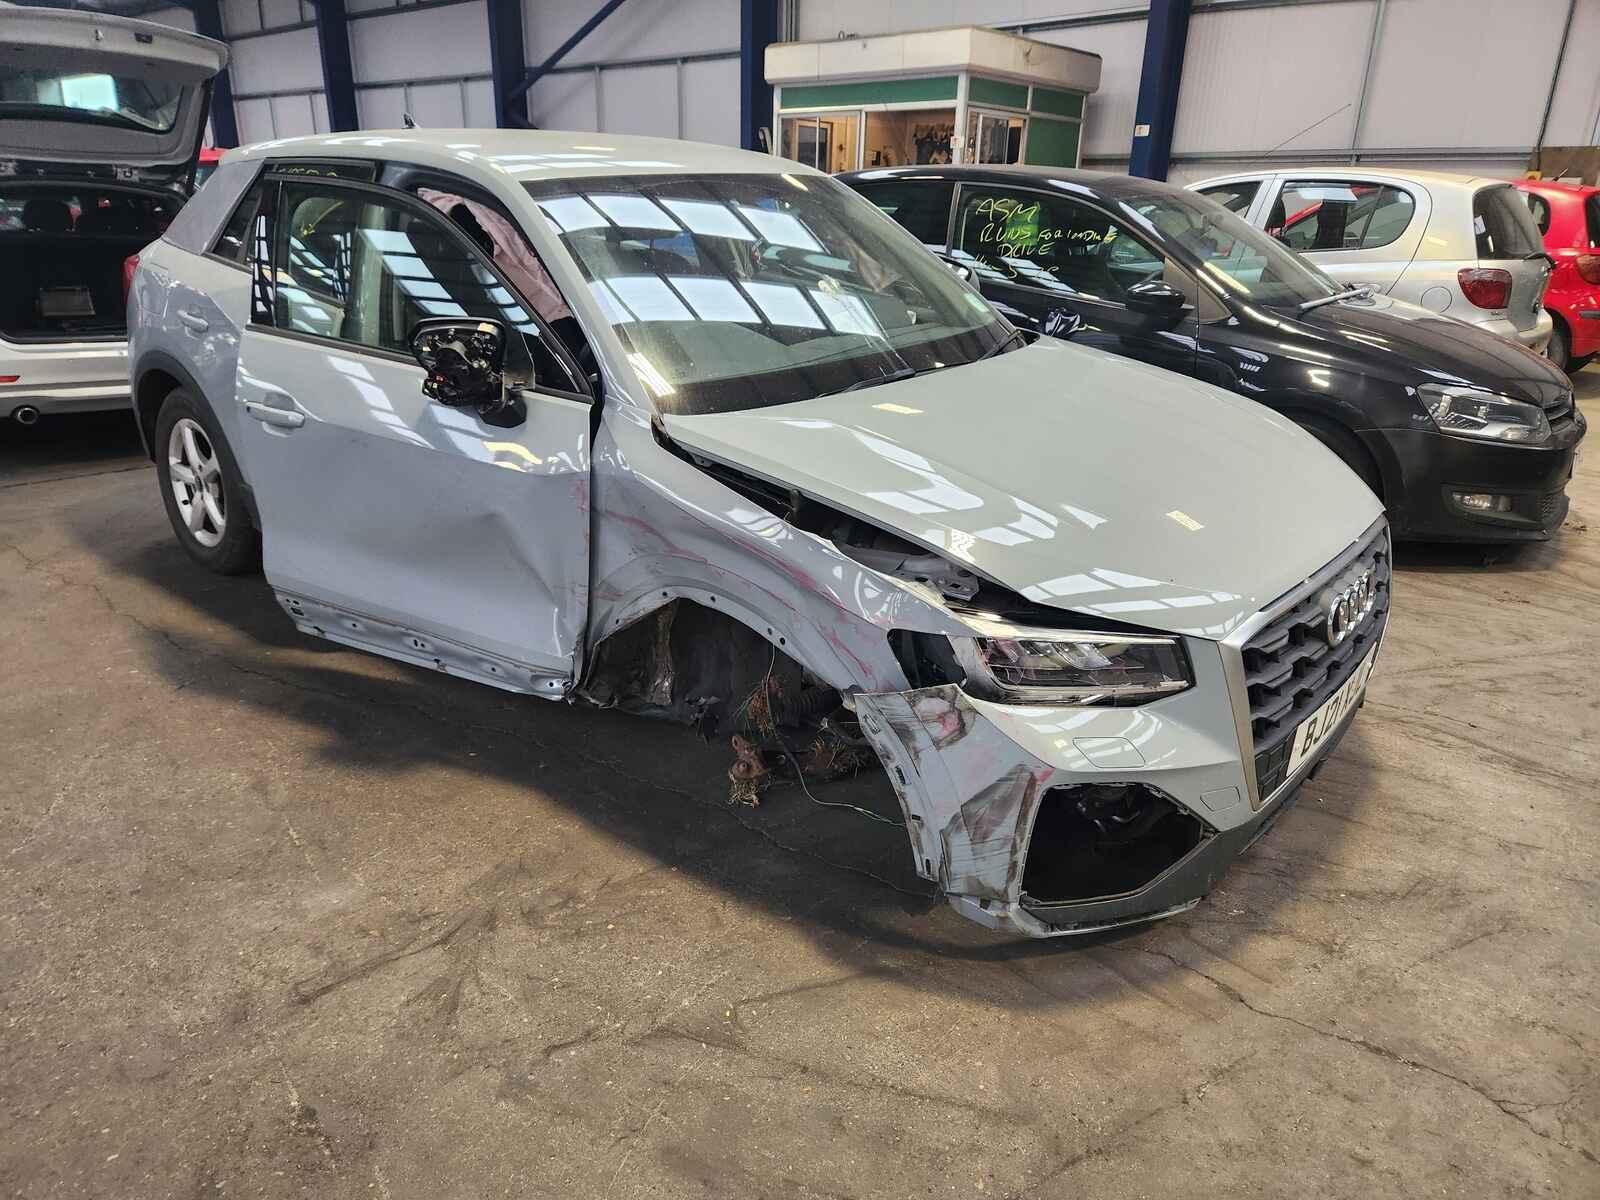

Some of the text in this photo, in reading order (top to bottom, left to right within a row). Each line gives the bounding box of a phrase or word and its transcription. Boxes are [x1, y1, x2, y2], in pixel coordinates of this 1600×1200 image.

[975, 198, 1040, 222] ASM
[980, 223, 1031, 242] RUNS
[1037, 228, 1063, 242] FOR
